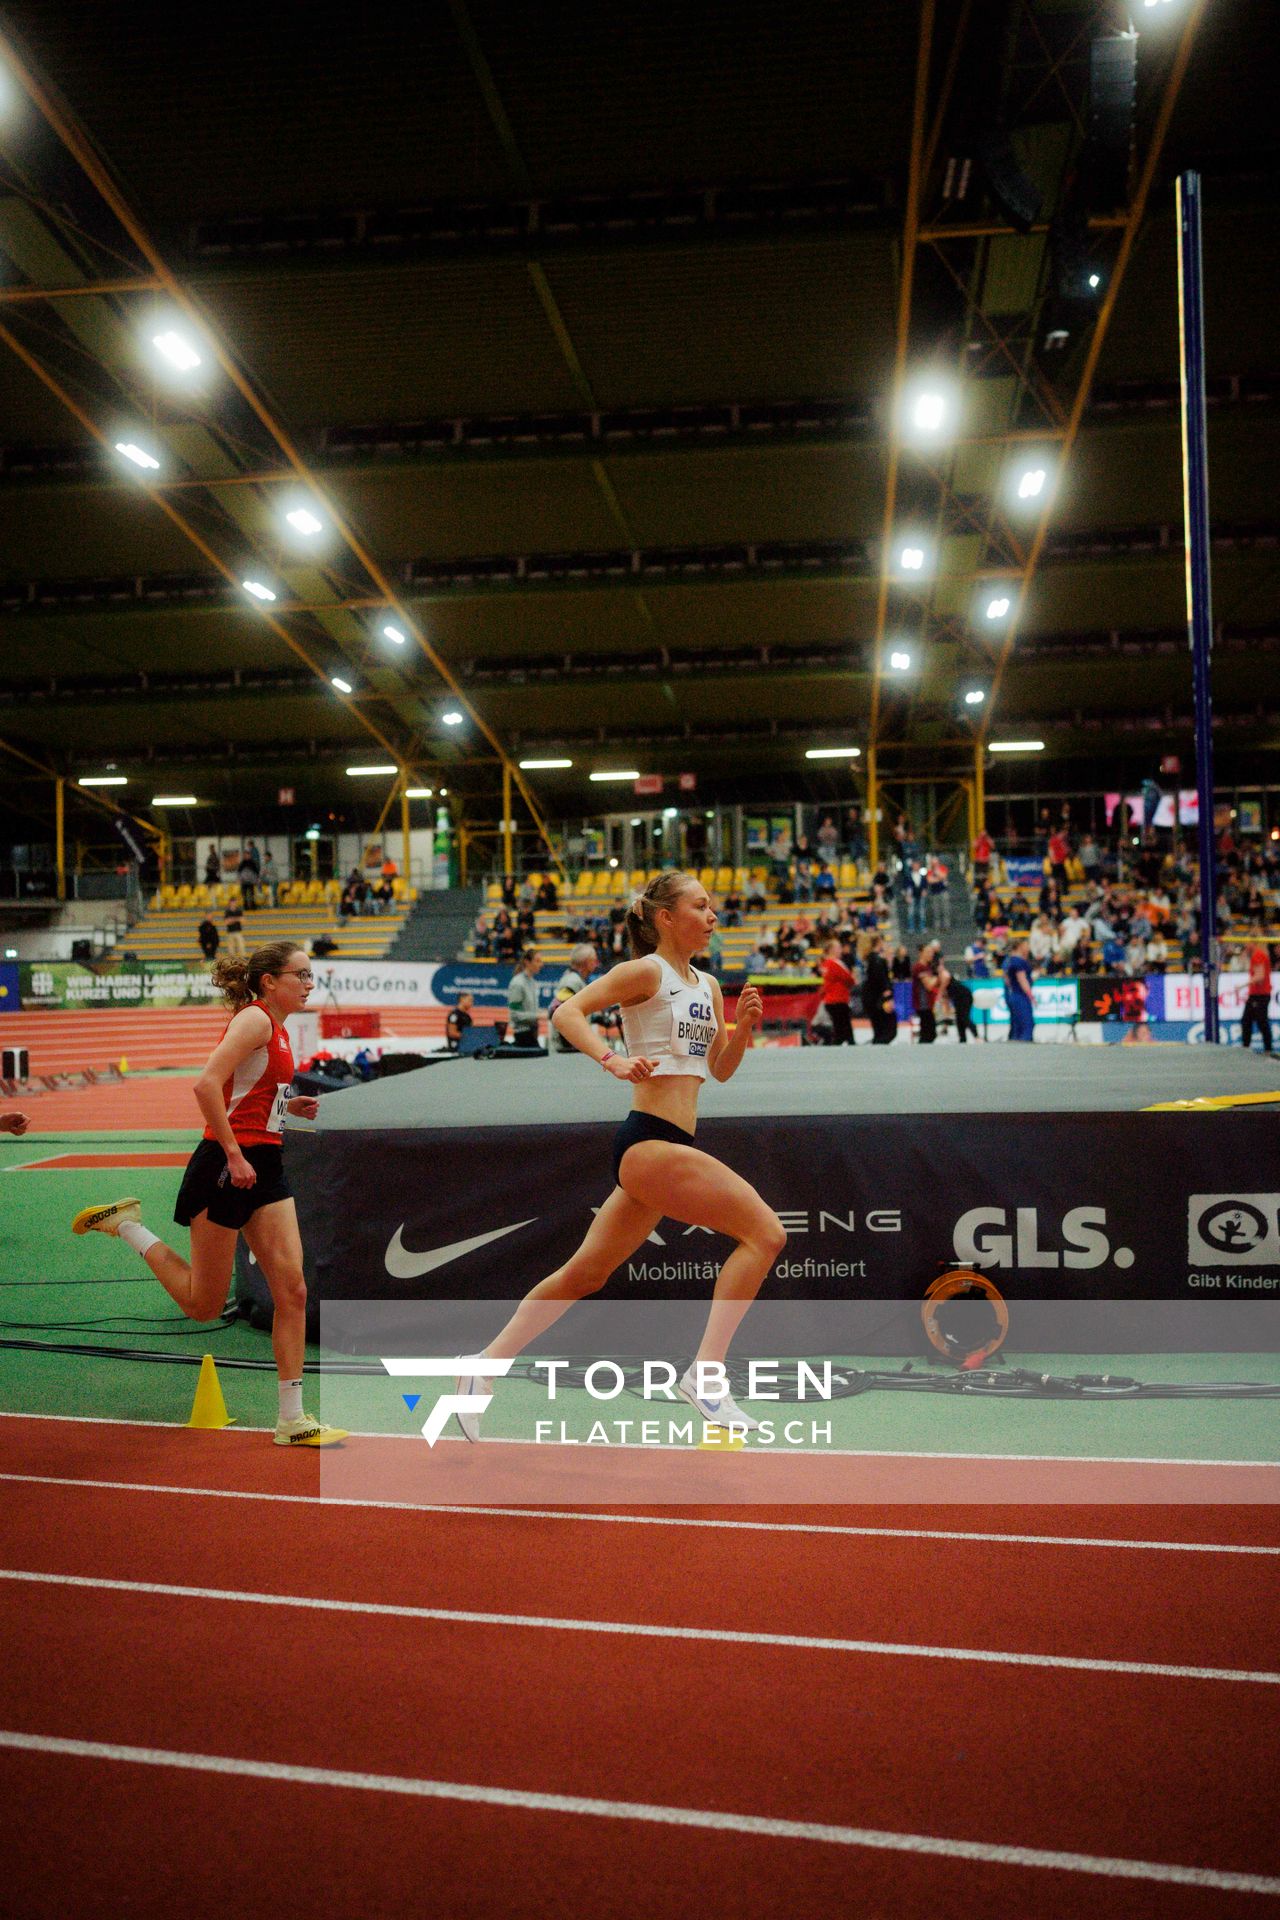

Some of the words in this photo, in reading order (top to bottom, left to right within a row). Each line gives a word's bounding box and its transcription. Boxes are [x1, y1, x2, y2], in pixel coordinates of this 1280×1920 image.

[113, 986, 141, 999] UND
[317, 974, 419, 993] NatuGena
[689, 1002, 711, 1021] GLS
[628, 1261, 720, 1283] Mobilität
[775, 1257, 867, 1279] definiert
[1188, 1273, 1221, 1288] Gibt
[1226, 1274, 1280, 1290] Kinder
